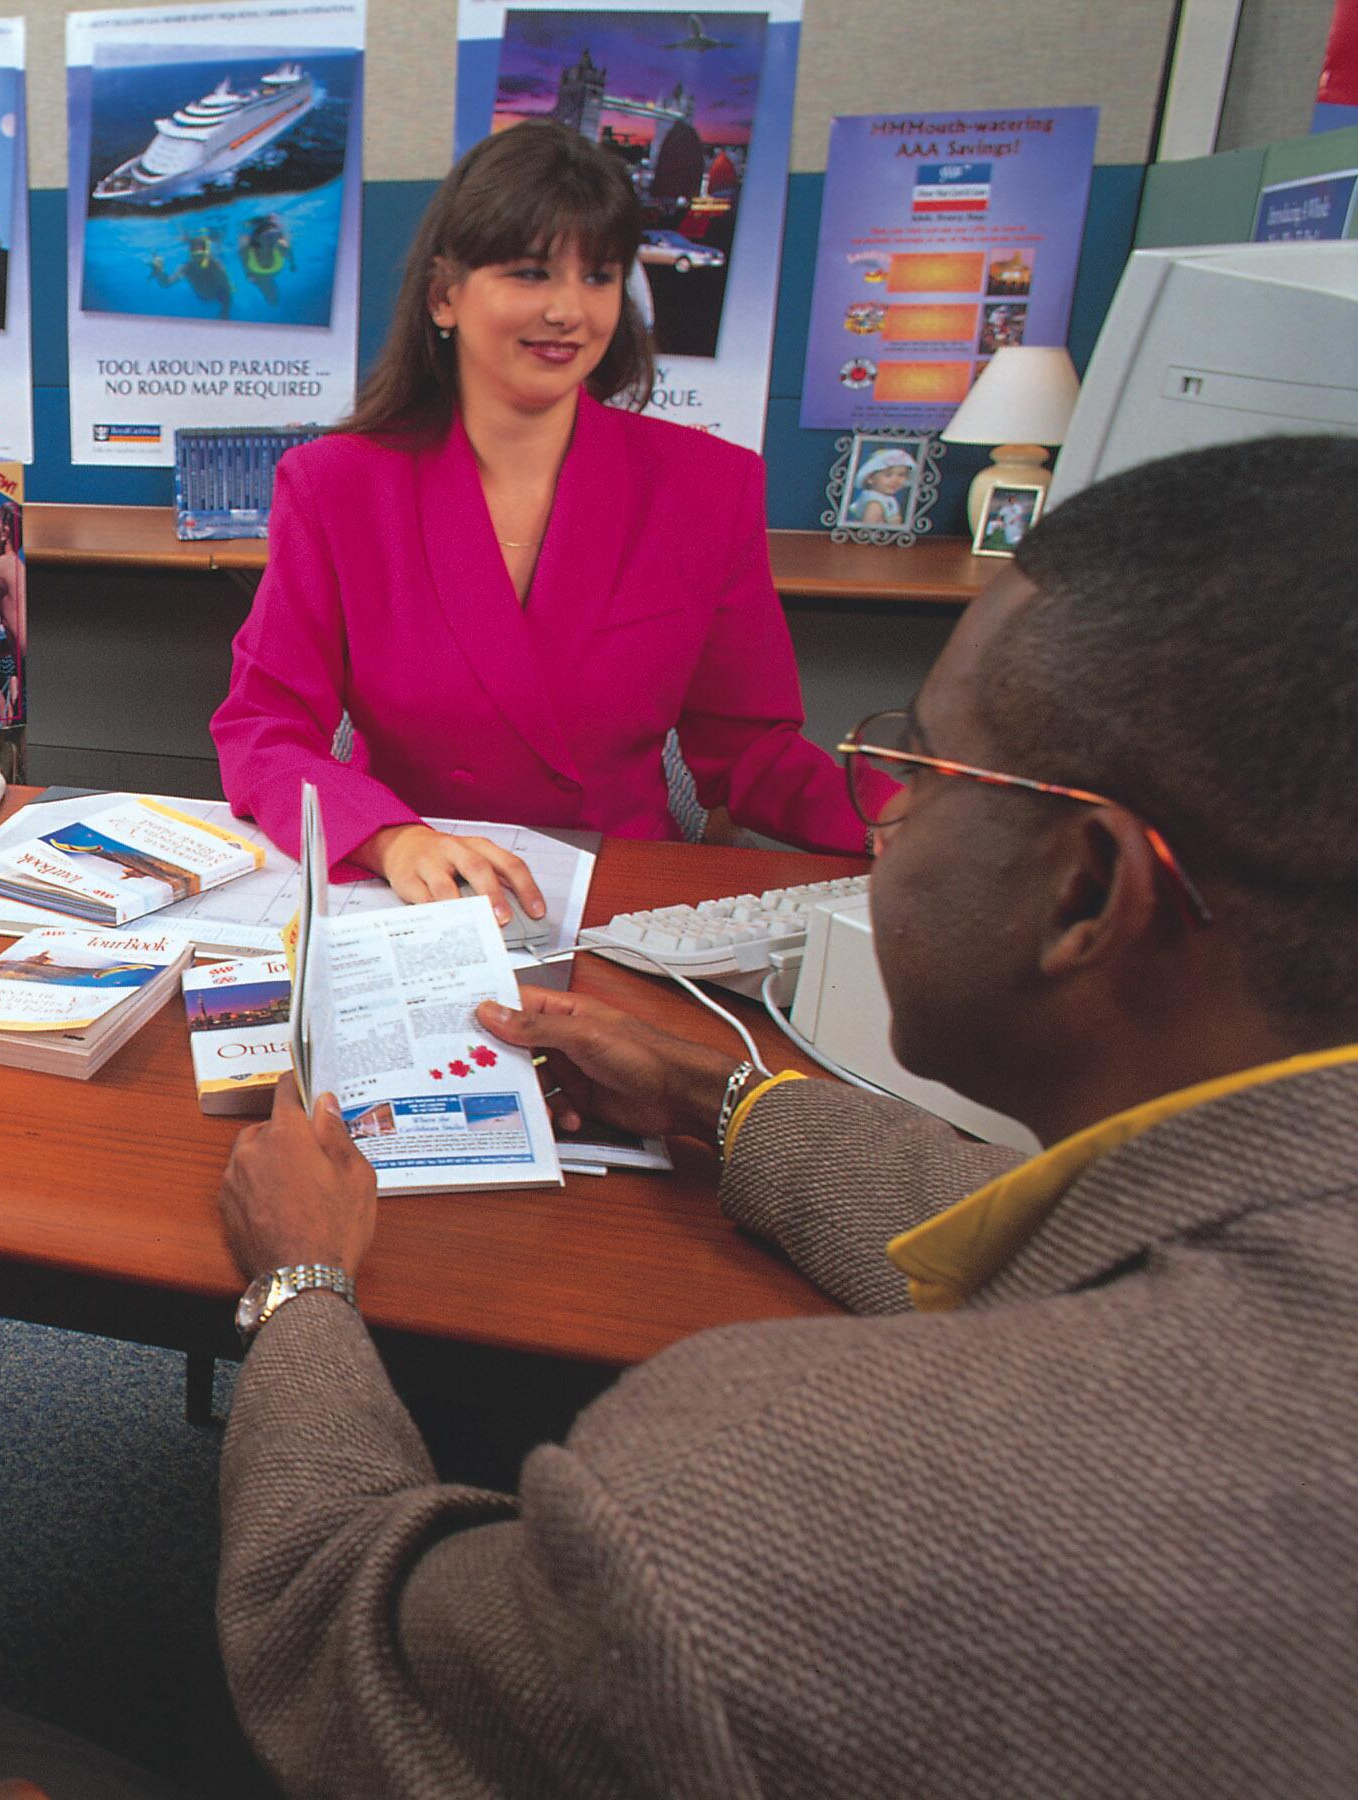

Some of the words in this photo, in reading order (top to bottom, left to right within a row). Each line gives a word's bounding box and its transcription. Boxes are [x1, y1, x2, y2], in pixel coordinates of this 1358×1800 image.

[895, 142, 940, 159] AAA
[97, 359, 142, 376] TOOL
[147, 359, 224, 377] AROUND
[228, 360, 311, 376] PARADISE
[105, 380, 133, 396] NO
[137, 380, 186, 396] ROAD
[192, 381, 228, 397] MAP
[233, 381, 322, 399] REQUIRED
[649, 389, 703, 410] QUE.
[217, 1042, 291, 1059] Onta
